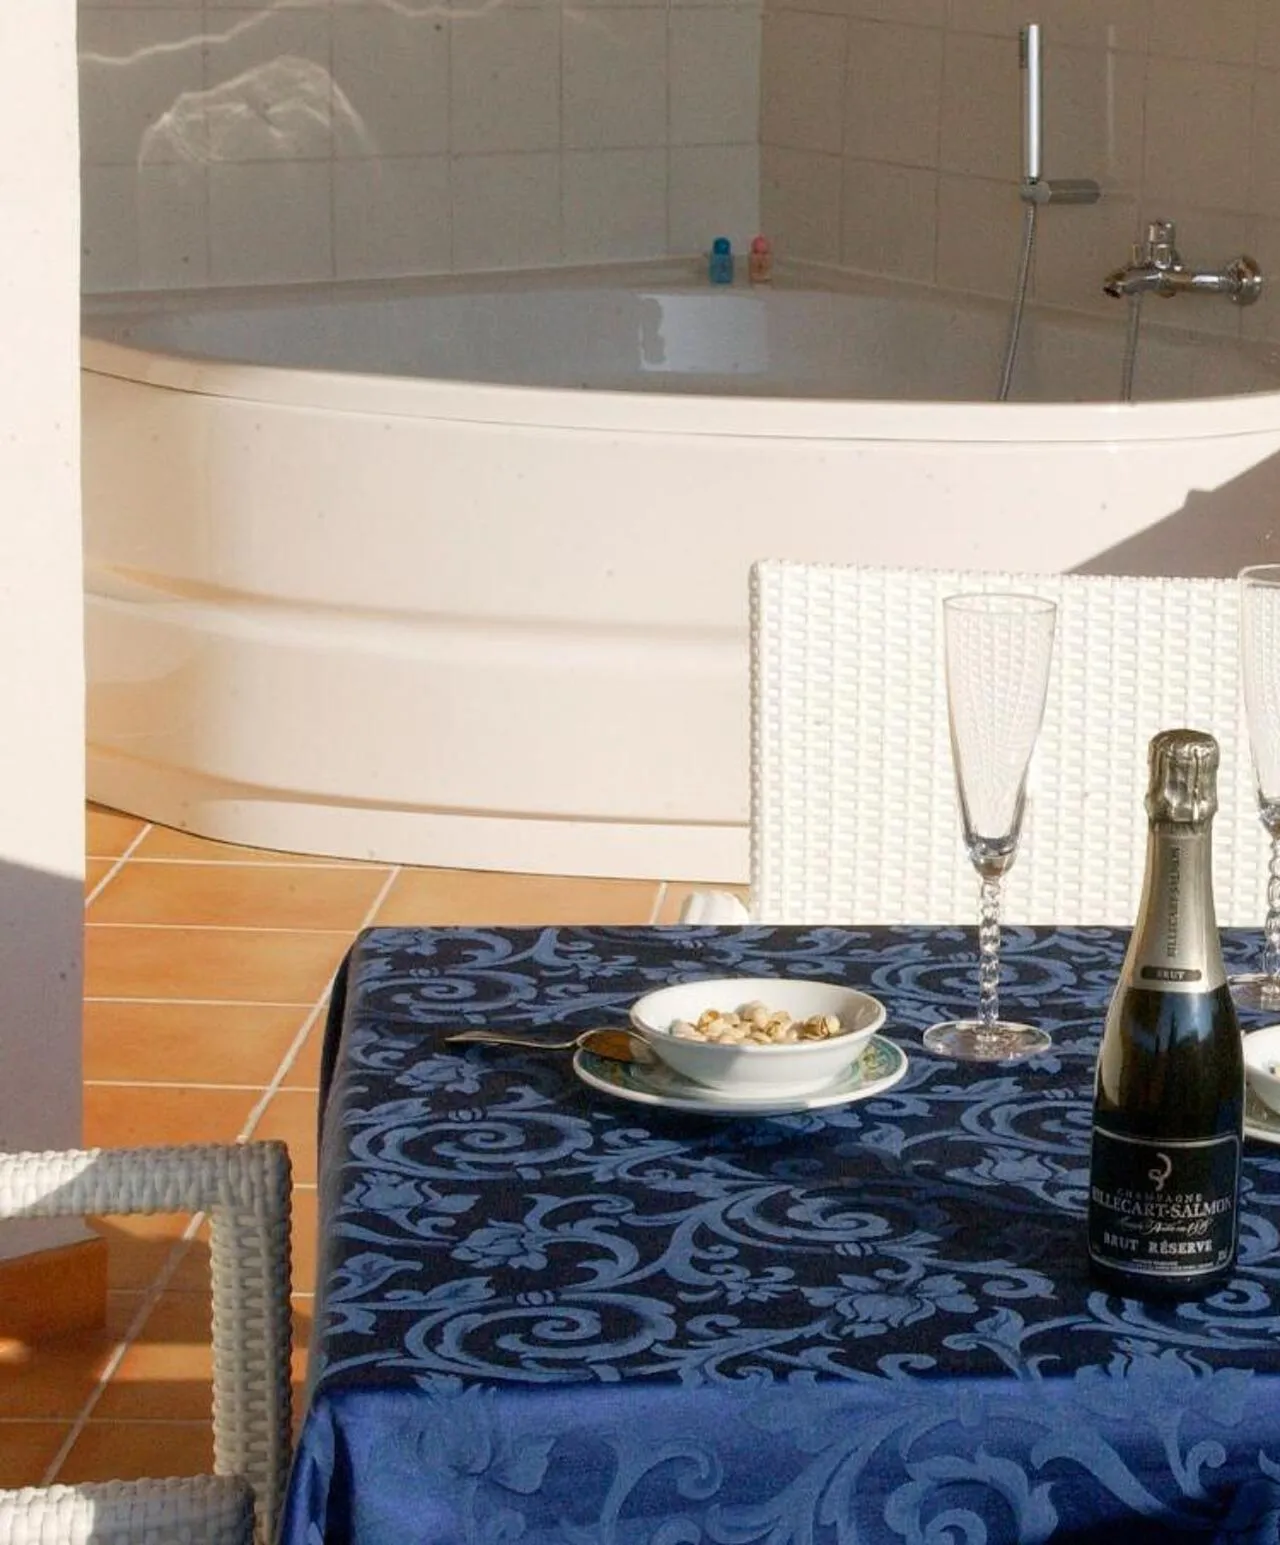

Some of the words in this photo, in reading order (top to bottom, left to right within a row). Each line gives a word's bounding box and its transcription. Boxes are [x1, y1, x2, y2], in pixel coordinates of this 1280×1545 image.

[1156, 969, 1186, 981] BRUT
[1103, 1231, 1139, 1251] BRUT
[1148, 1239, 1213, 1255] RÉSERVE
